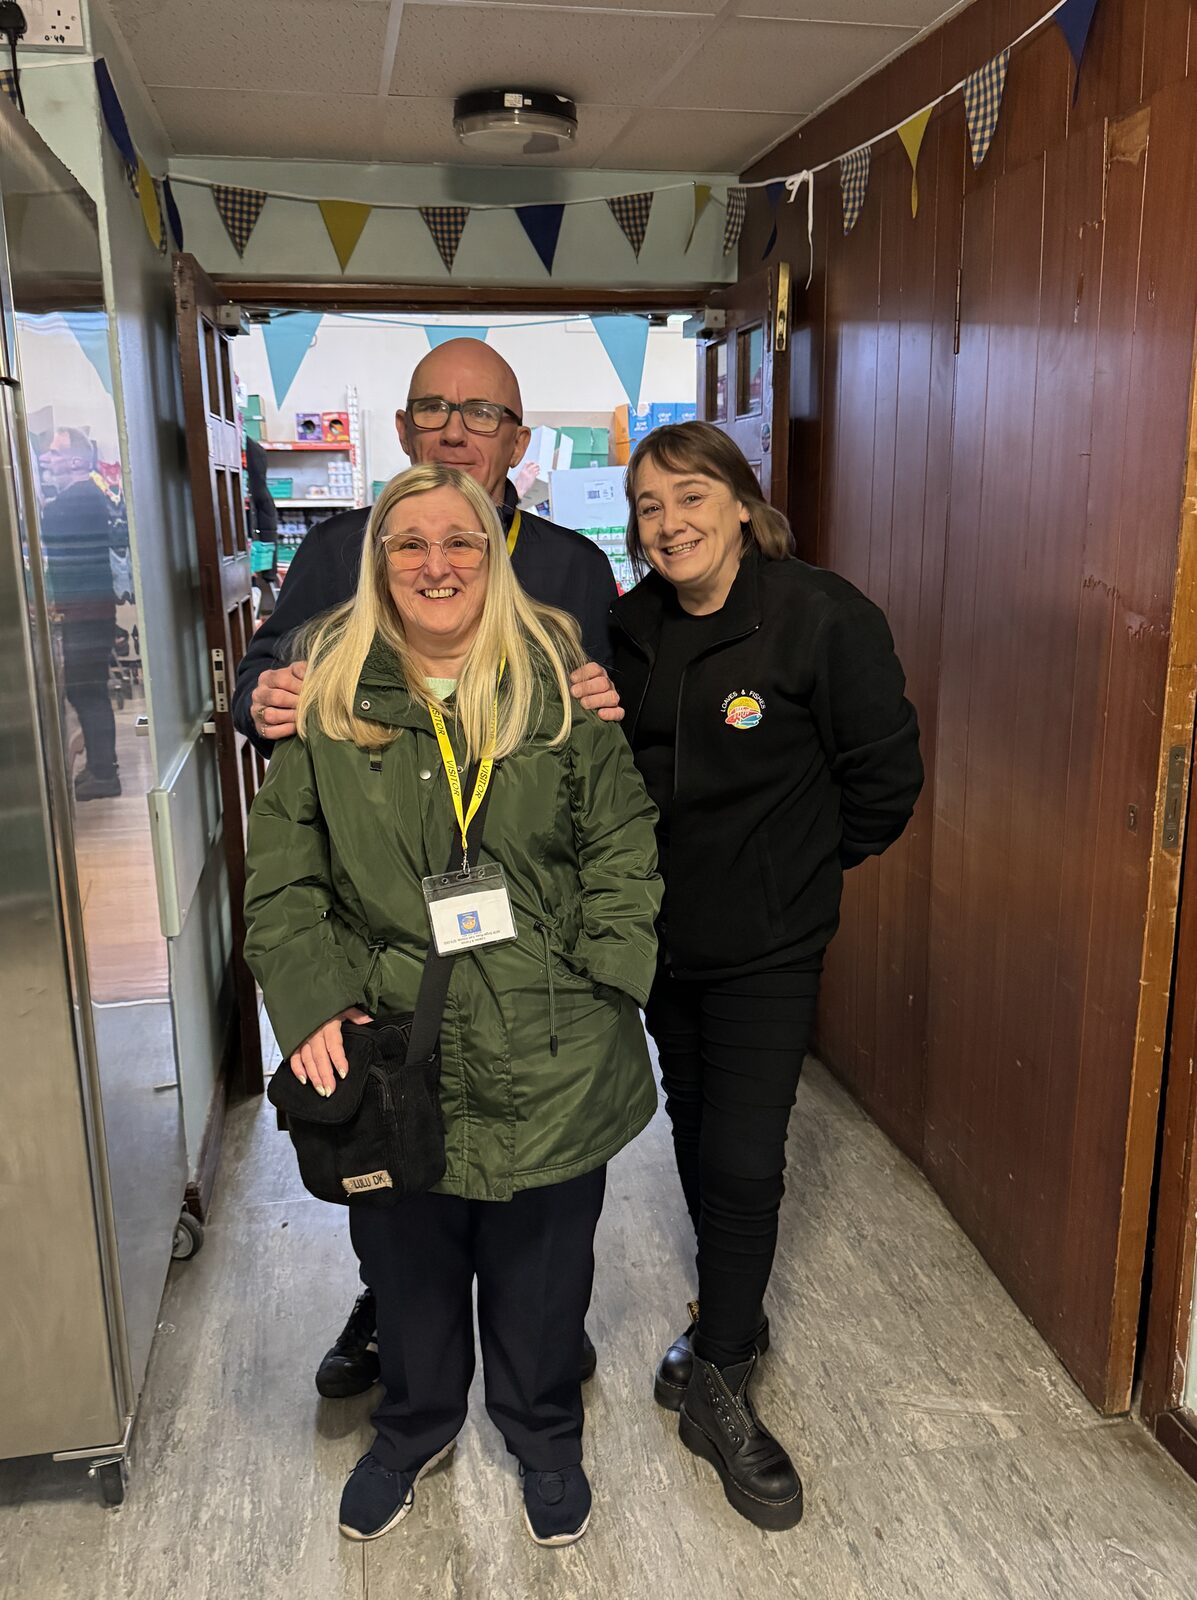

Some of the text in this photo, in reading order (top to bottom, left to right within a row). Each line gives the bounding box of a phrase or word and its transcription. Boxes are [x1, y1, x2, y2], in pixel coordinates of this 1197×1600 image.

[720, 691, 738, 713] LOAVES
[749, 690, 766, 709] FISHES
[446, 760, 460, 797] VISITOR
[474, 765, 490, 799] VISITOR
[353, 1173, 384, 1188] LULU DK
